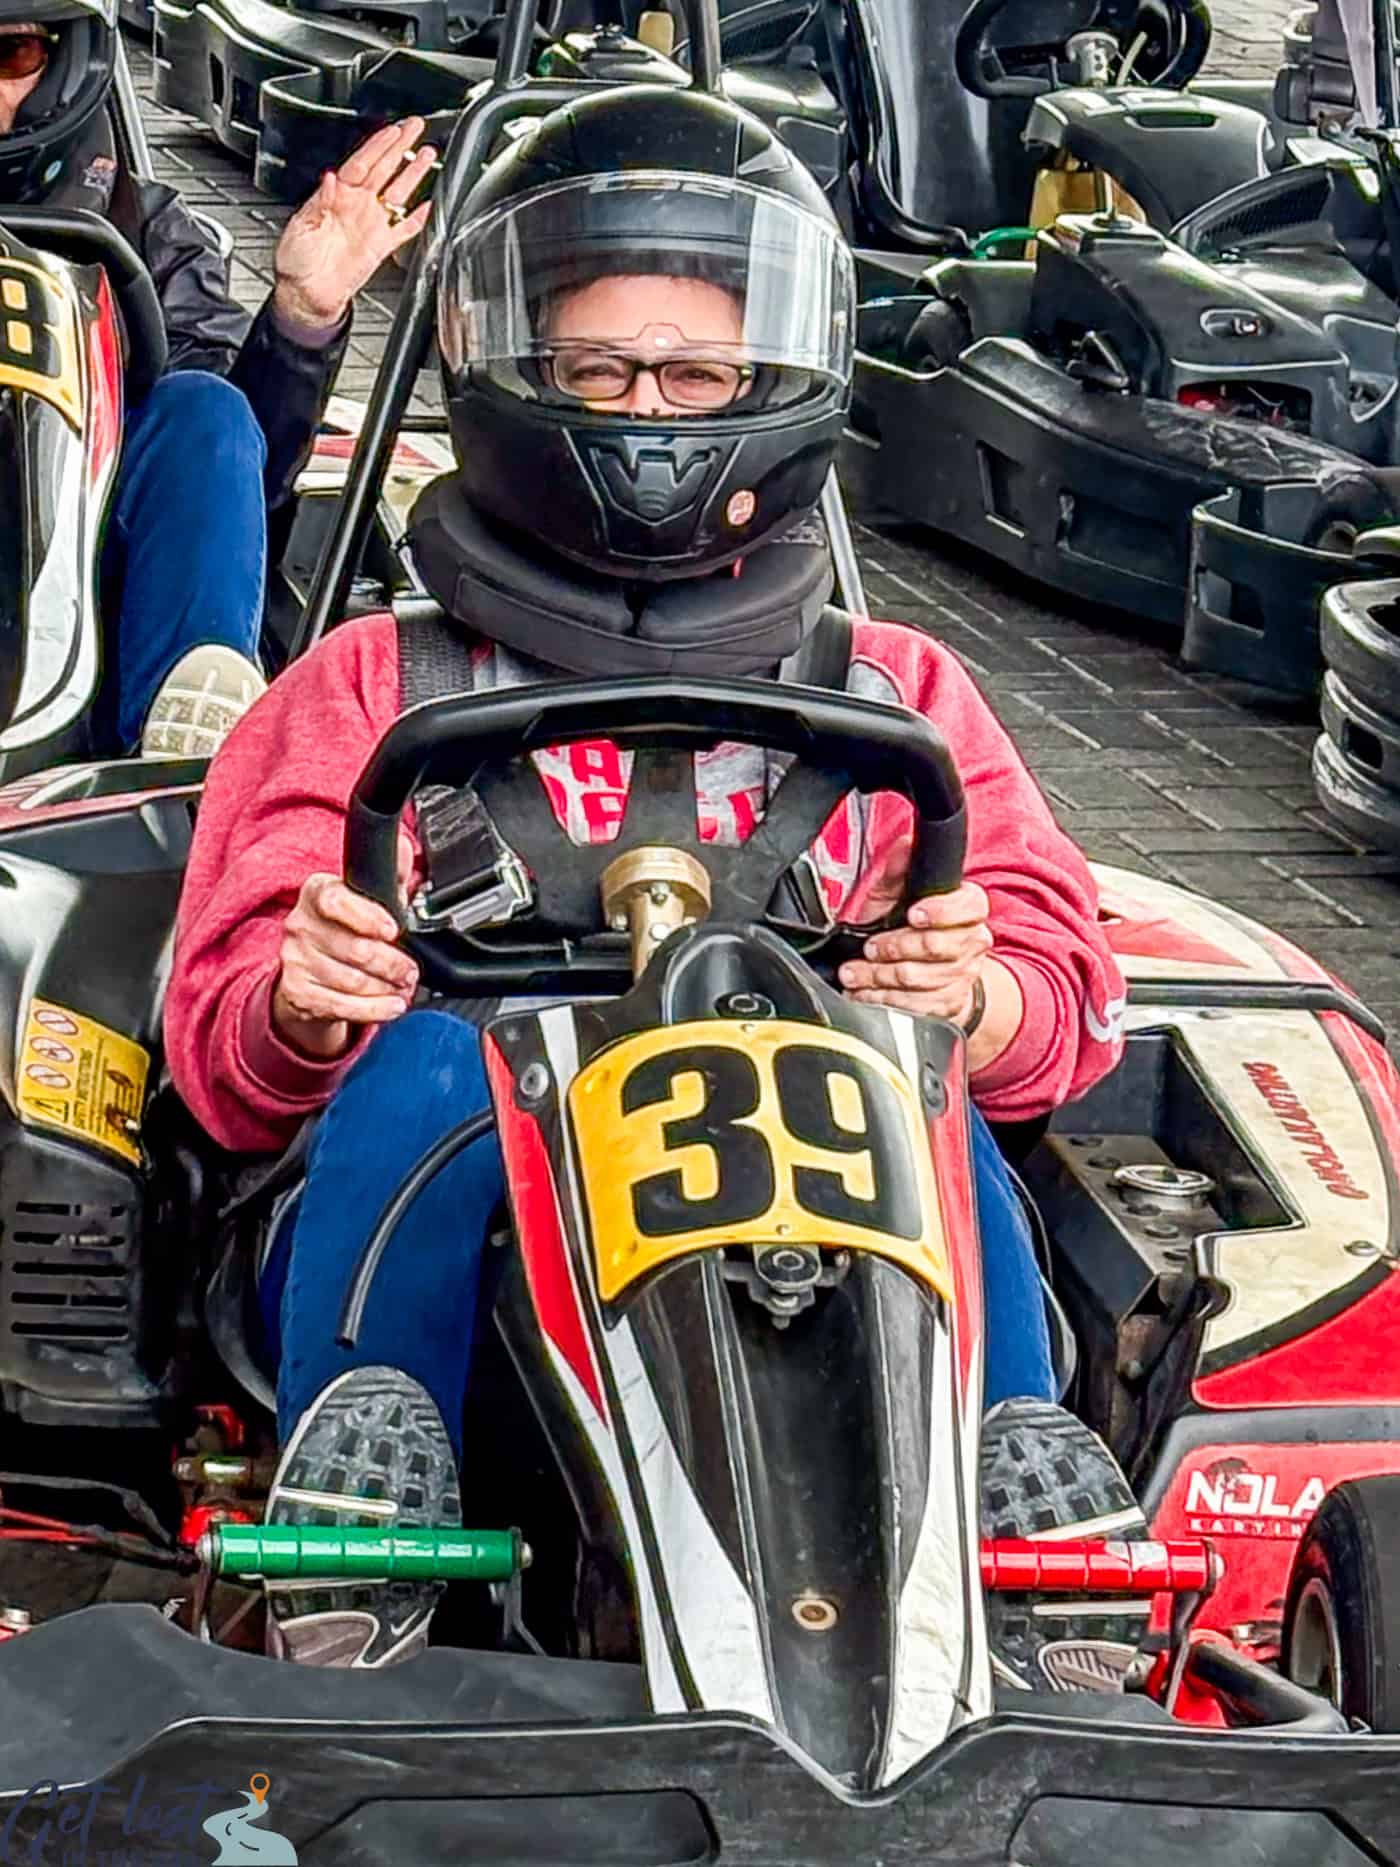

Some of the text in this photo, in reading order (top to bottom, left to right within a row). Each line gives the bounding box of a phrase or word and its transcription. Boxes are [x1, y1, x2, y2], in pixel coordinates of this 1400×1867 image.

[621, 1044, 923, 1242] 39
[1185, 1470, 1327, 1518] NOLA
[1190, 1518, 1307, 1538] KARTIN
